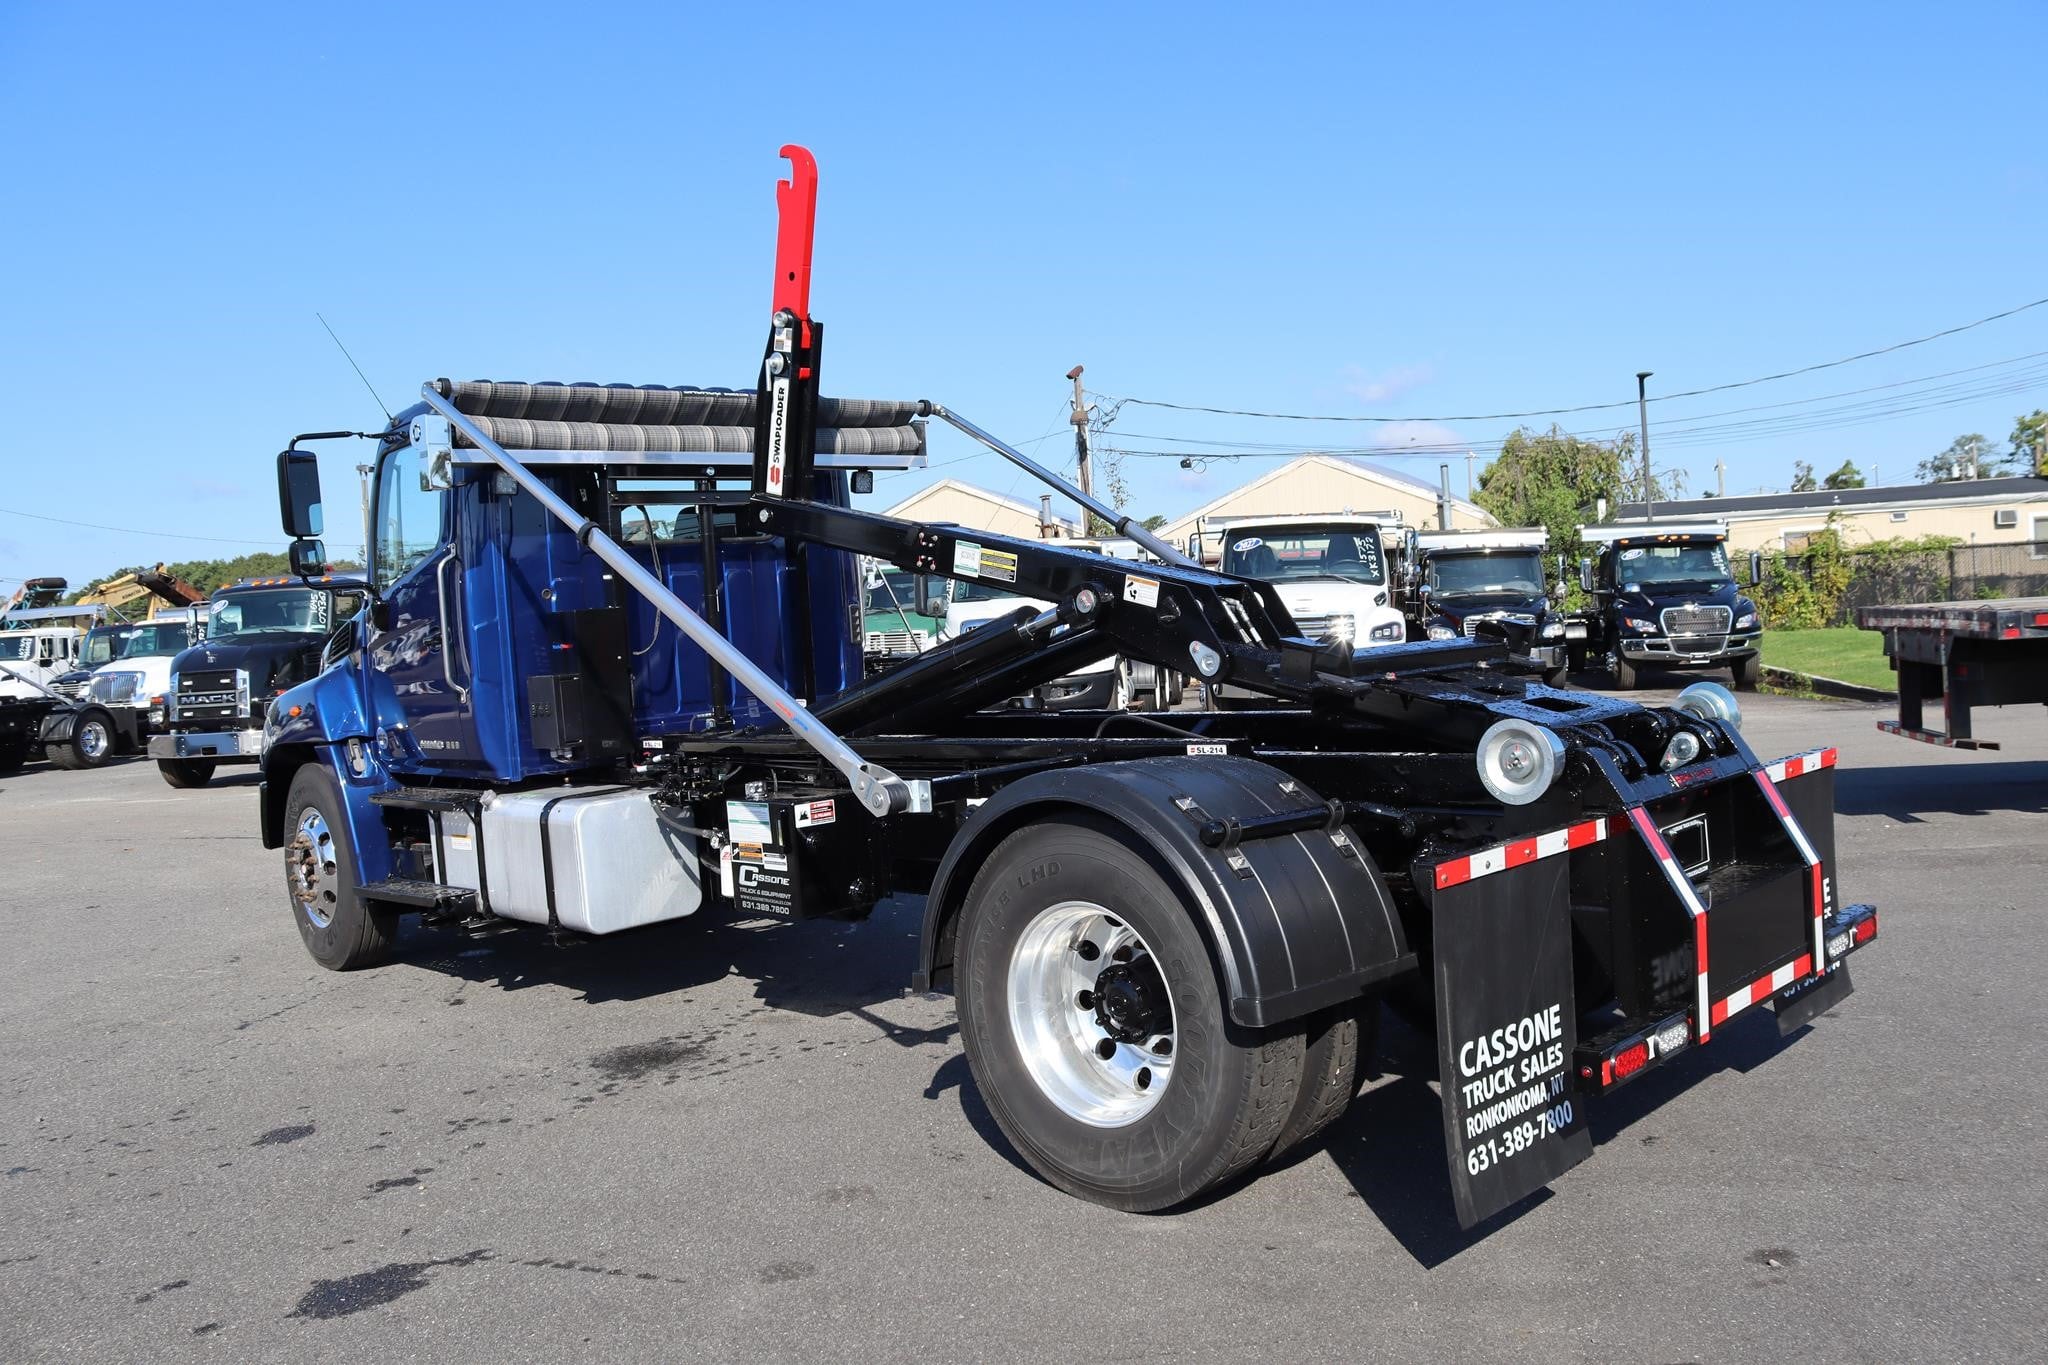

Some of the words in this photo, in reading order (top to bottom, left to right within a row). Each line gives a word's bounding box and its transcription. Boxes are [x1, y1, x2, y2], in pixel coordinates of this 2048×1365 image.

[772, 386, 786, 463] SWAPLOADER
[180, 693, 236, 704] MACK
[1196, 746, 1224, 754] SL-214
[739, 864, 790, 887] CASSONE
[1017, 861, 1062, 889] LHD
[739, 886, 757, 895] TRUCK
[761, 889, 791, 900] EQUIPMENT
[741, 900, 790, 915] 631.389.7800
[1459, 1003, 1562, 1078] CASSONE
[1462, 1064, 1517, 1110] TRUCK
[1520, 1042, 1564, 1083] SALES
[1466, 1082, 1551, 1140] RONKONKOMA,
[1550, 1071, 1565, 1097] NY
[1467, 1099, 1573, 1176] 631-389-7800
